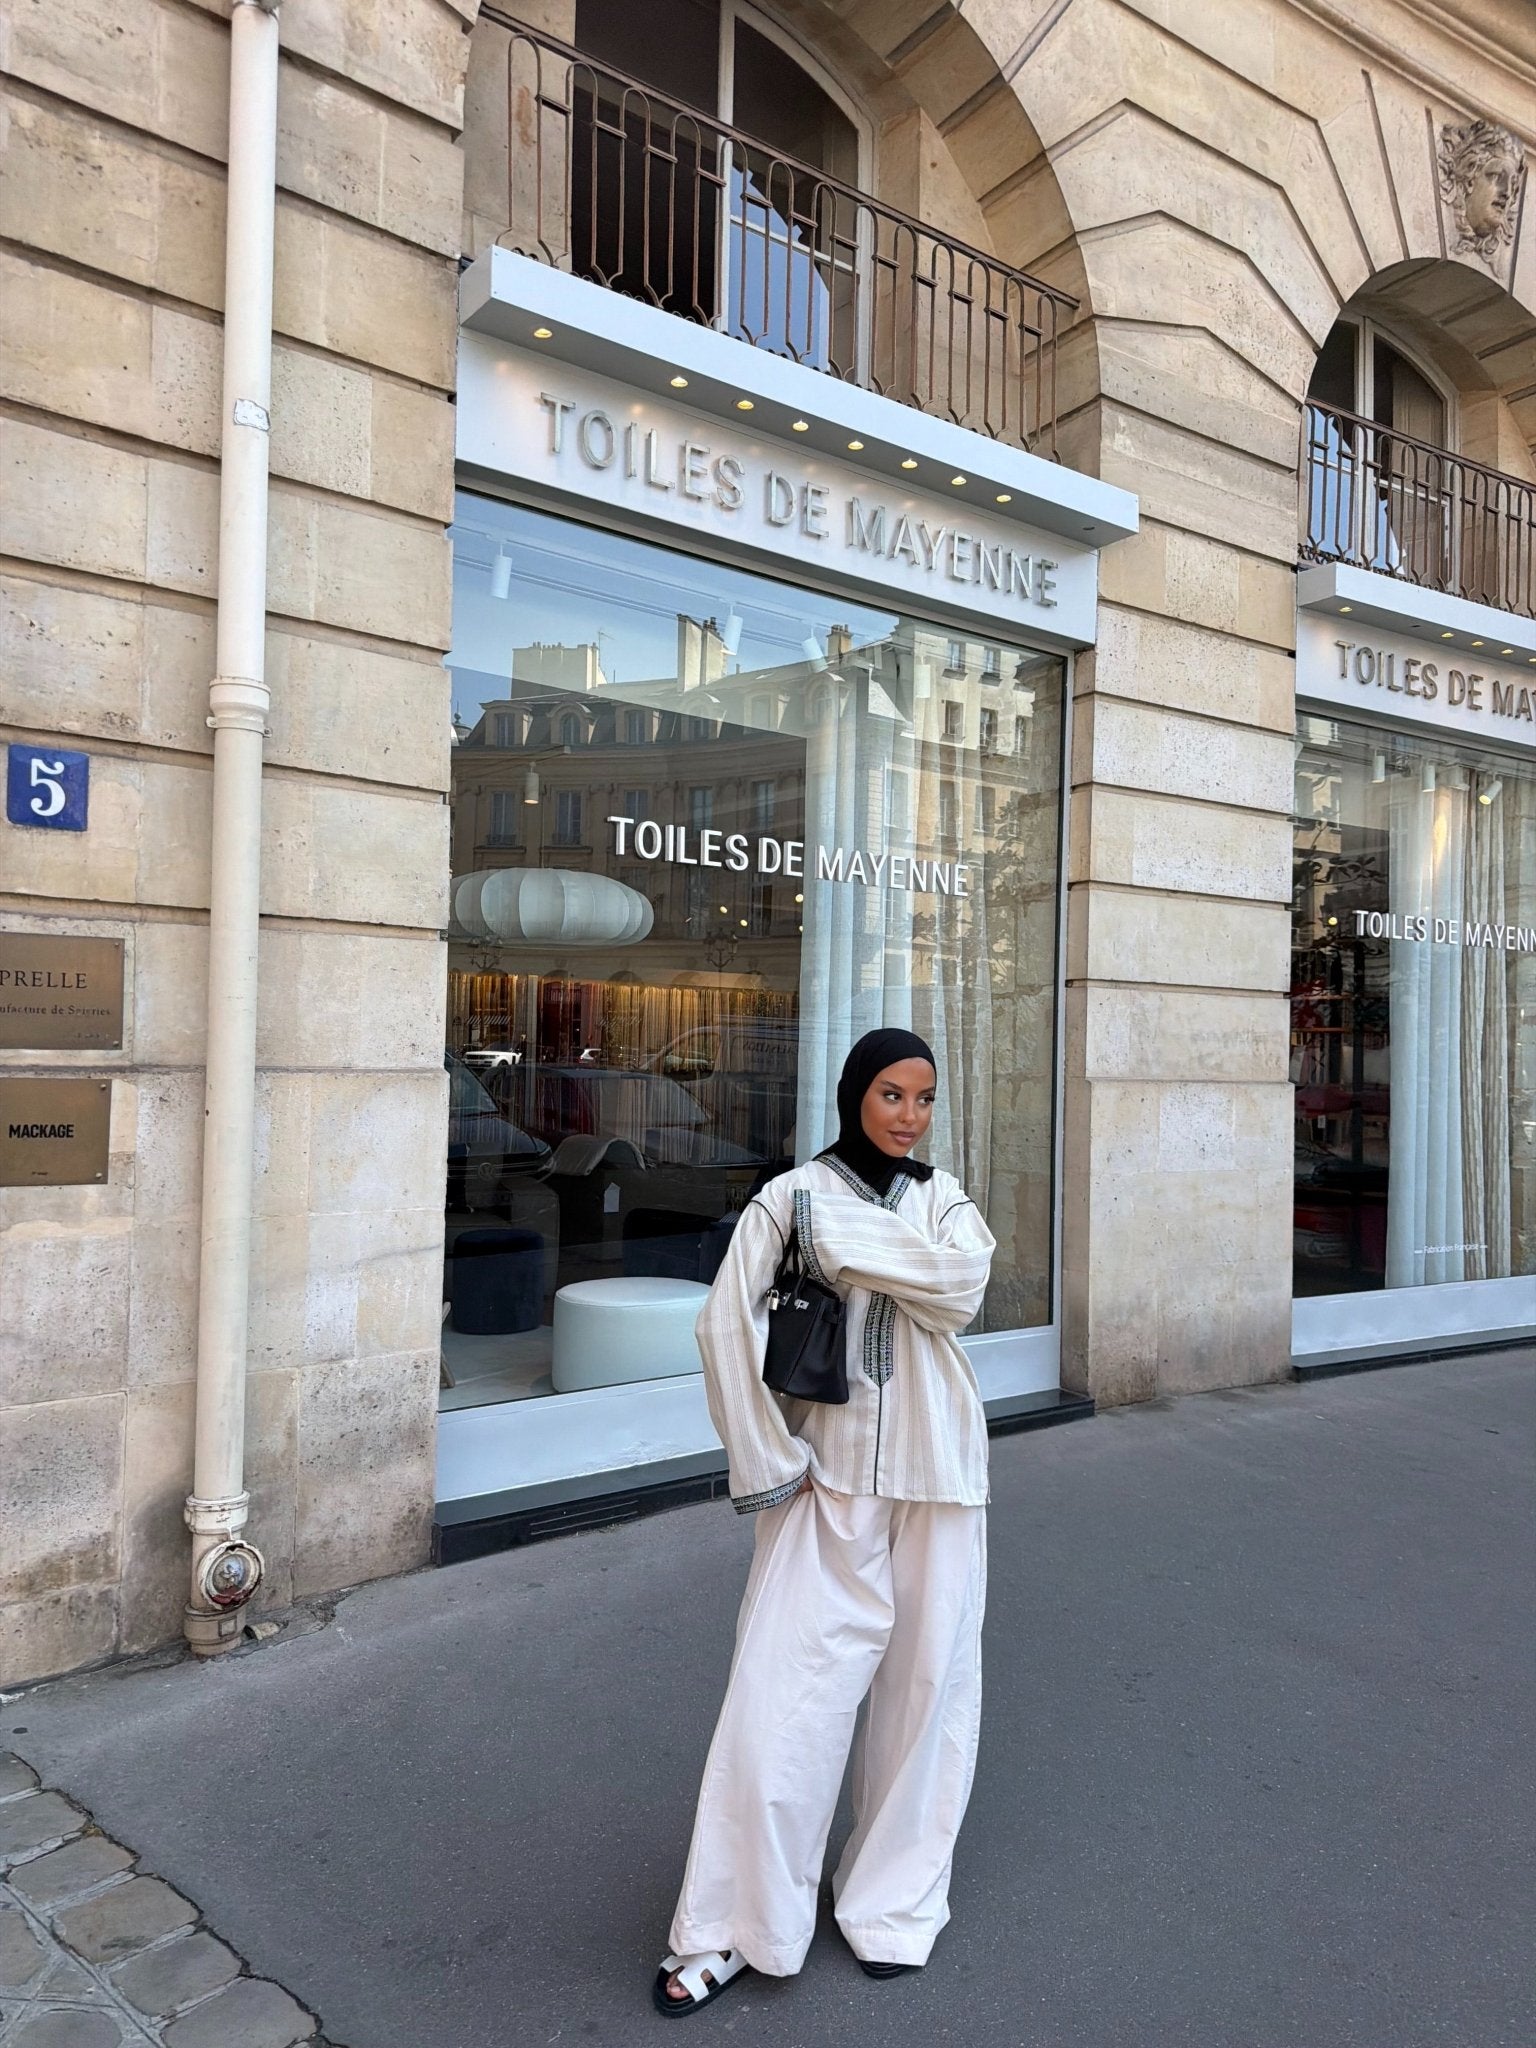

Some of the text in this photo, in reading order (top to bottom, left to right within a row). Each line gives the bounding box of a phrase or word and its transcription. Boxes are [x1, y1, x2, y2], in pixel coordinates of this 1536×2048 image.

[540, 391, 1059, 607] TOILES DE MAYENNE
[1334, 640, 1439, 700] TOILES
[1448, 670, 1484, 711] DE
[31, 758, 66, 816] 5
[607, 815, 969, 897] TOILES DE MAYENNE
[1353, 909, 1428, 942] TOILES
[1434, 918, 1459, 945] DE
[0, 970, 88, 989] PRELLE
[51, 1004, 65, 1015] de
[8, 1124, 75, 1139] MACKAGE
